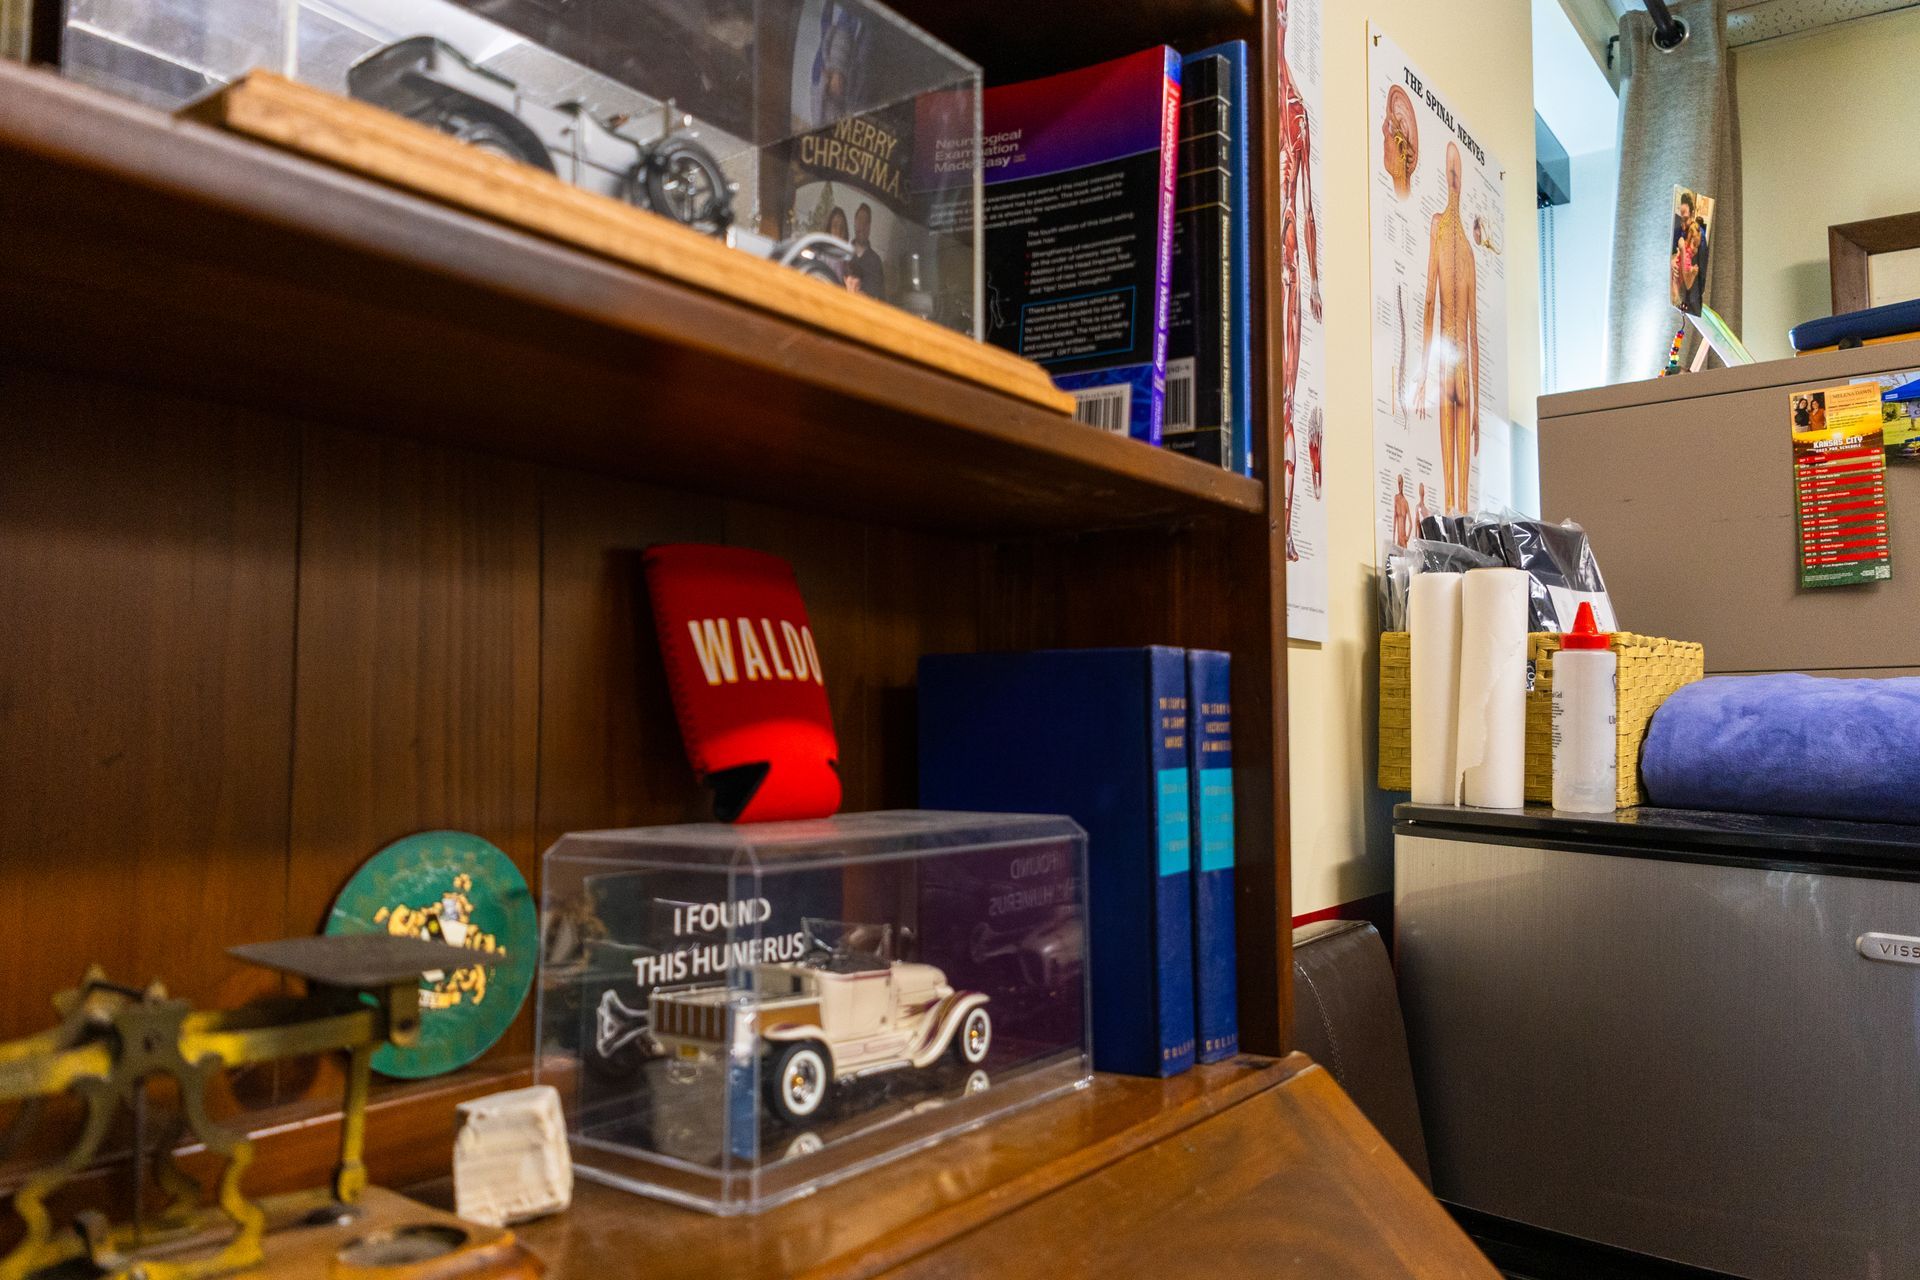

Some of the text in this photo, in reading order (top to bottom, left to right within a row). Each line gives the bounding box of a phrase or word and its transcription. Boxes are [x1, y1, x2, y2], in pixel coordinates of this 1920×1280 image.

[834, 118, 897, 160] MERRY
[1404, 67, 1485, 166] THE SPINAL NERVES
[801, 136, 900, 198] CHRISTMA
[1164, 98, 1177, 192] Neurological
[1161, 191, 1174, 282] Examination
[1158, 285, 1169, 330] Made
[1156, 333, 1167, 373] Easy
[1814, 436, 1863, 448] KANSAS CITY
[688, 617, 823, 686] WALDO
[674, 898, 772, 936] I FOUND
[632, 950, 688, 987] THIS
